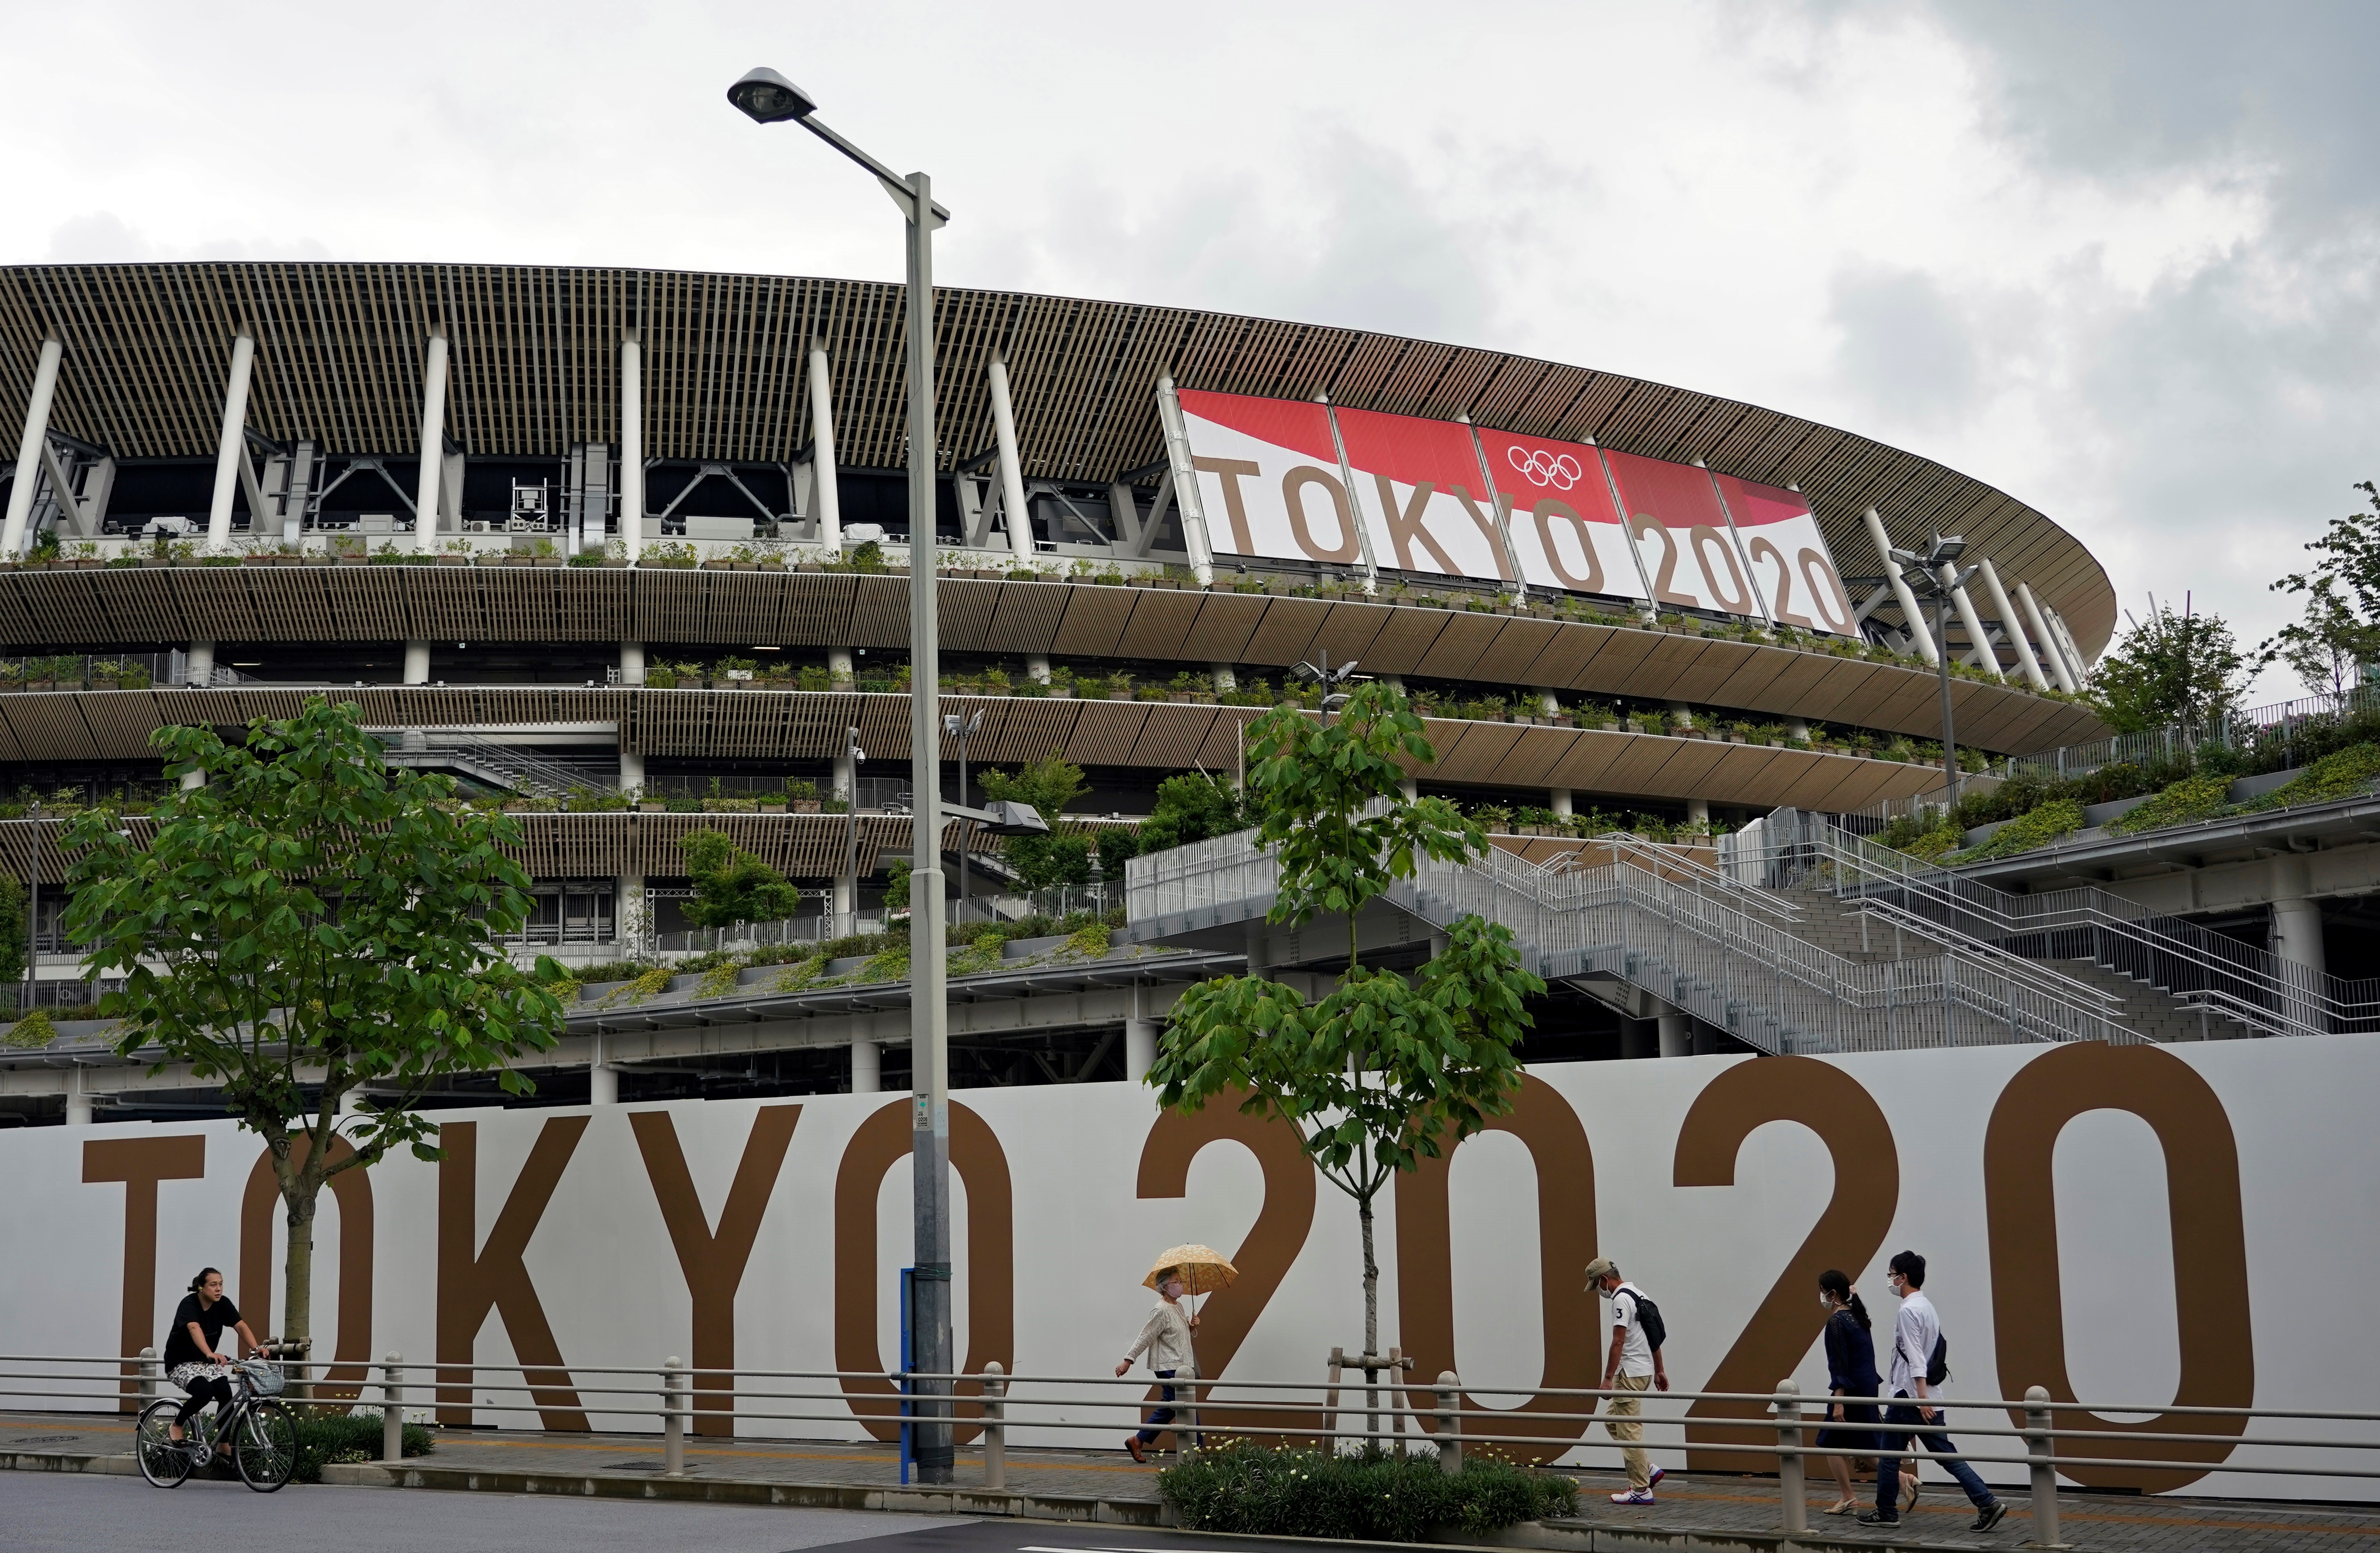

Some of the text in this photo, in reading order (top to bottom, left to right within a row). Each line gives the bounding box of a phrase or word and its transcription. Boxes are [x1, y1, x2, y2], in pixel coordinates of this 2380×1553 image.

[1192, 456, 1857, 636] TOKYO 2020
[82, 1039, 2255, 1495] TOKYO 2020
[1616, 1308, 1622, 1319] 3
